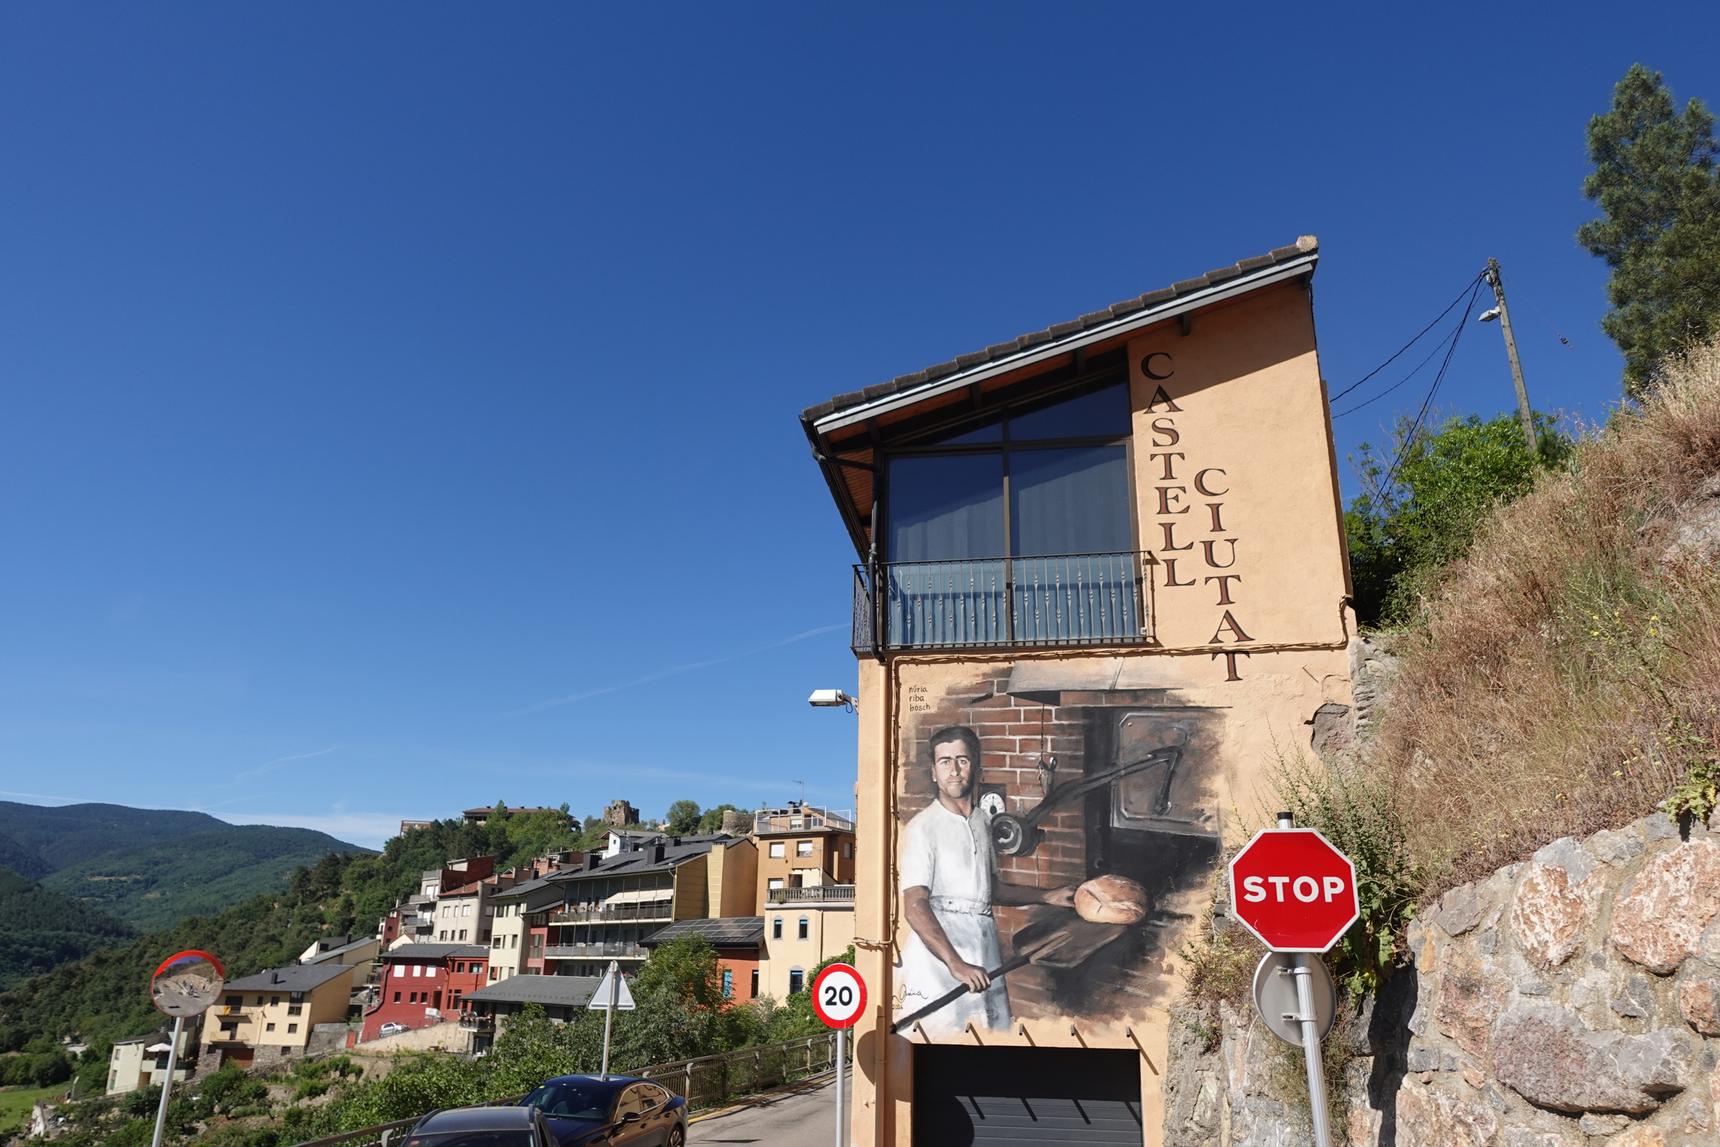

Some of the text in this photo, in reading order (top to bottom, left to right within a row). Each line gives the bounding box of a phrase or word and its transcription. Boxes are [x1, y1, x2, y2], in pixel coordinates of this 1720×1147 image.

[1140, 351, 1197, 588] CASTELL
[1193, 467, 1256, 683] CIUTAT
[908, 694, 925, 702] riba
[909, 703, 931, 712] bosch
[1243, 875, 1346, 903] STOP
[824, 985, 853, 1007] 20
